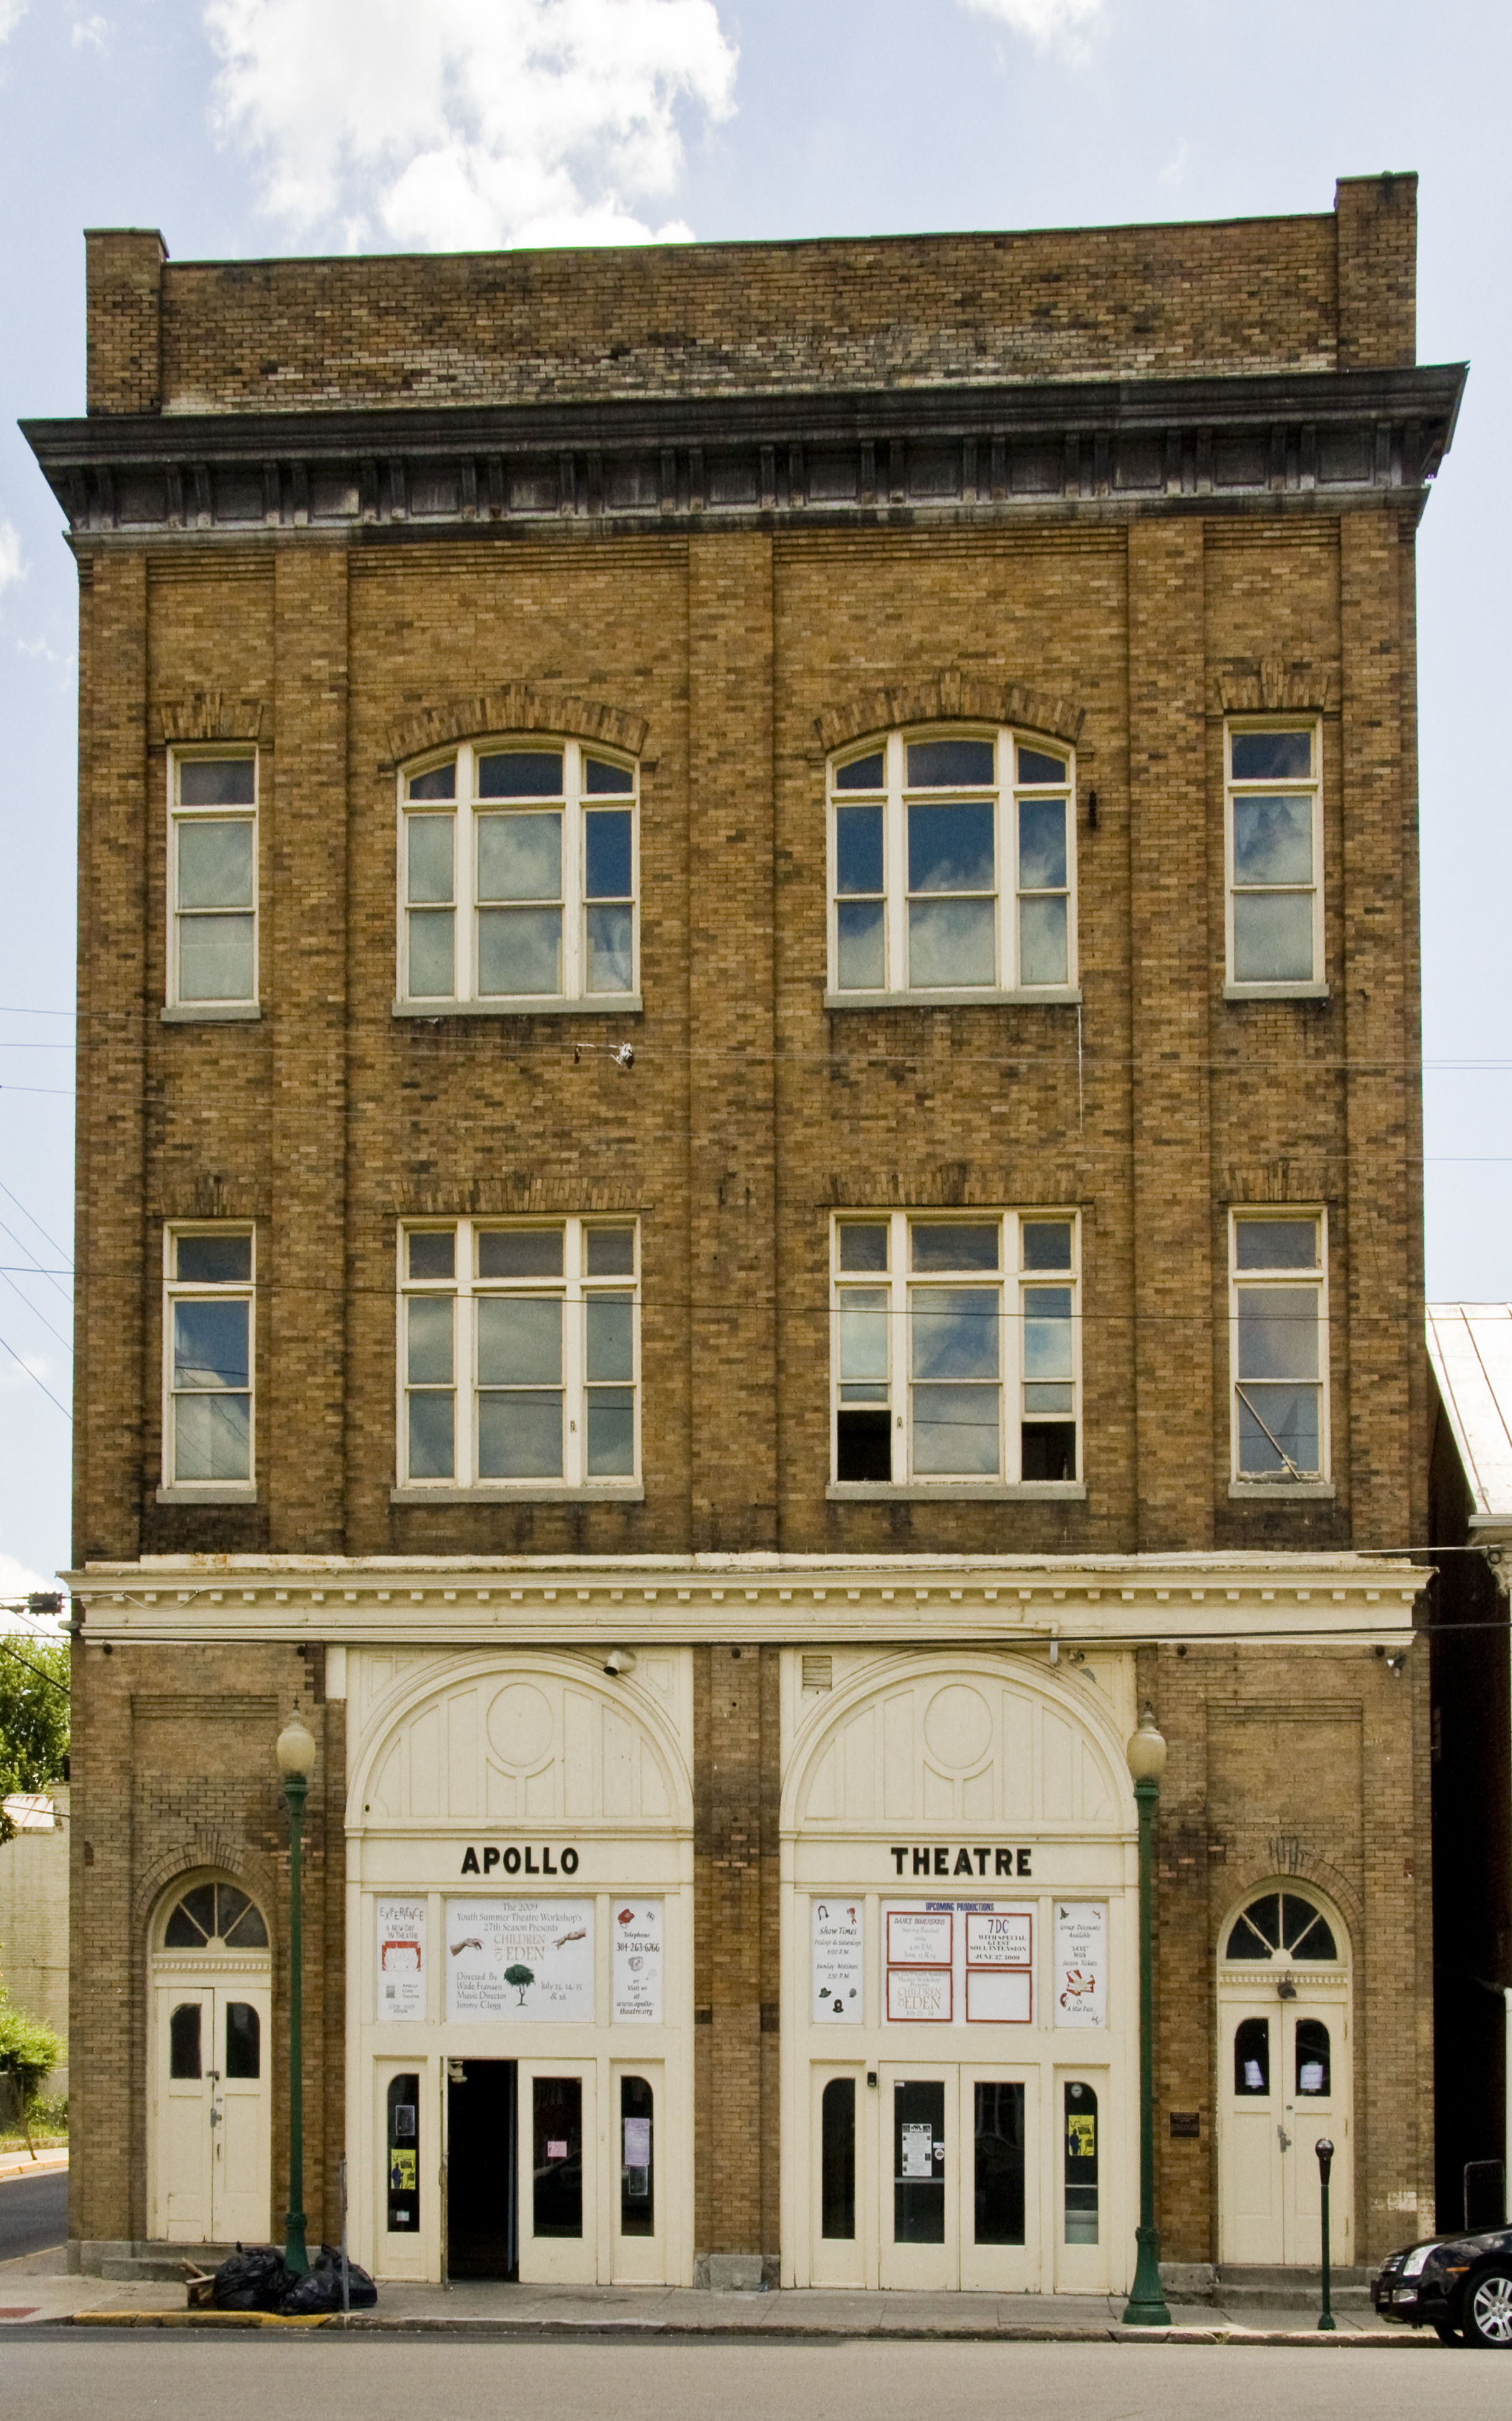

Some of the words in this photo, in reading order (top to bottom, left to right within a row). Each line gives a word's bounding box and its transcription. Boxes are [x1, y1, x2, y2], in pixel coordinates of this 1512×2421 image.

[461, 1847, 579, 1874] APOLLO
[891, 1847, 1031, 1876] THEATRE
[503, 1903, 516, 1911] The
[519, 1903, 538, 1911] 2009
[926, 1902, 954, 1911] UPCOMING
[956, 1903, 994, 1912] PRODUCTIONS
[380, 1907, 424, 1921] EXPERIENCE
[457, 1913, 478, 1921] Youth
[479, 1913, 509, 1921] Summer
[540, 1913, 582, 1923] Workshop's
[484, 1923, 501, 1931] 27th
[503, 1923, 527, 1932] Season
[529, 1923, 558, 1932] Presents
[819, 1926, 837, 1935] Show
[494, 1934, 546, 1945] CHILDREN
[506, 1946, 545, 1961] EDEN
[457, 1972, 485, 1981] Directed
[489, 1973, 498, 1981] By
[456, 1982, 474, 1990] Wade
[457, 1991, 478, 2000] Music
[479, 1991, 506, 2000] Director
[898, 1988, 941, 1996] CHILDREN
[456, 2000, 478, 2009] Jimmy
[480, 2001, 501, 2010] Clegg
[905, 1995, 940, 2009] EDEN
[620, 2008, 653, 2016] theatre.org
